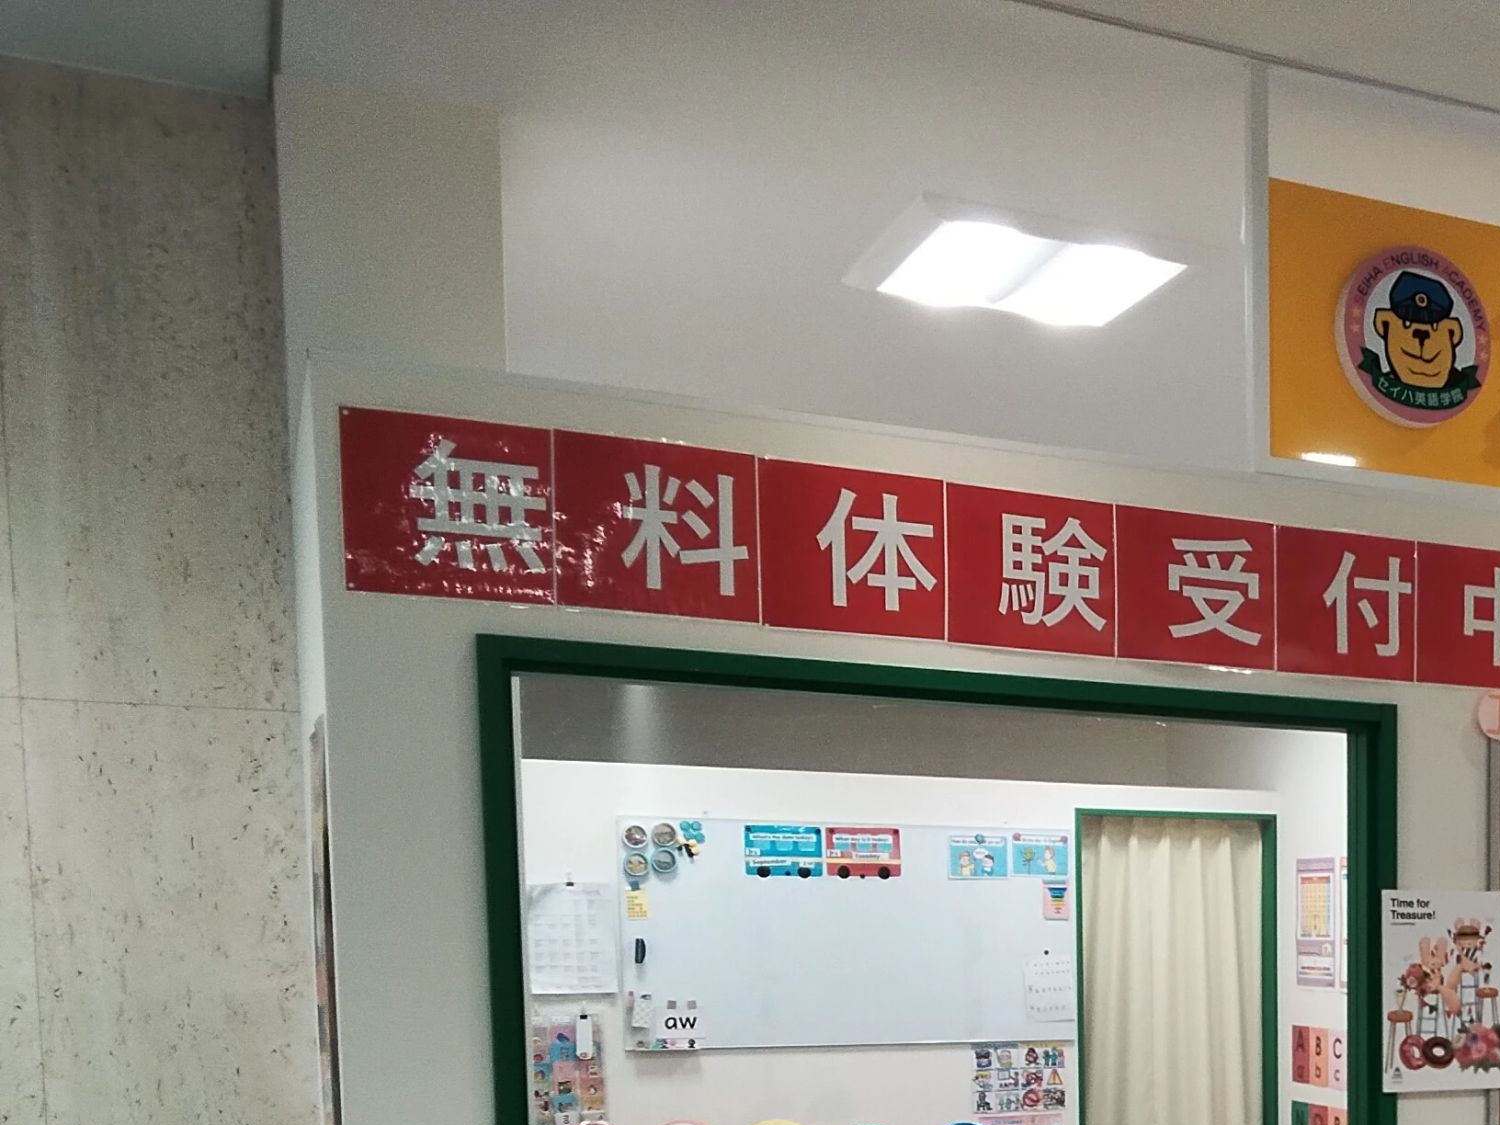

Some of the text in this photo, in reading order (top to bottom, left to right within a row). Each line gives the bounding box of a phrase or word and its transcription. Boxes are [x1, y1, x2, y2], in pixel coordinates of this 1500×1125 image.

[1377, 376, 1465, 407] セイハ英語学院
[1390, 897, 1430, 909] Time for
[1390, 909, 1436, 921] Treasure!
[664, 1016, 697, 1030] aw
[1333, 1038, 1342, 1059] C
